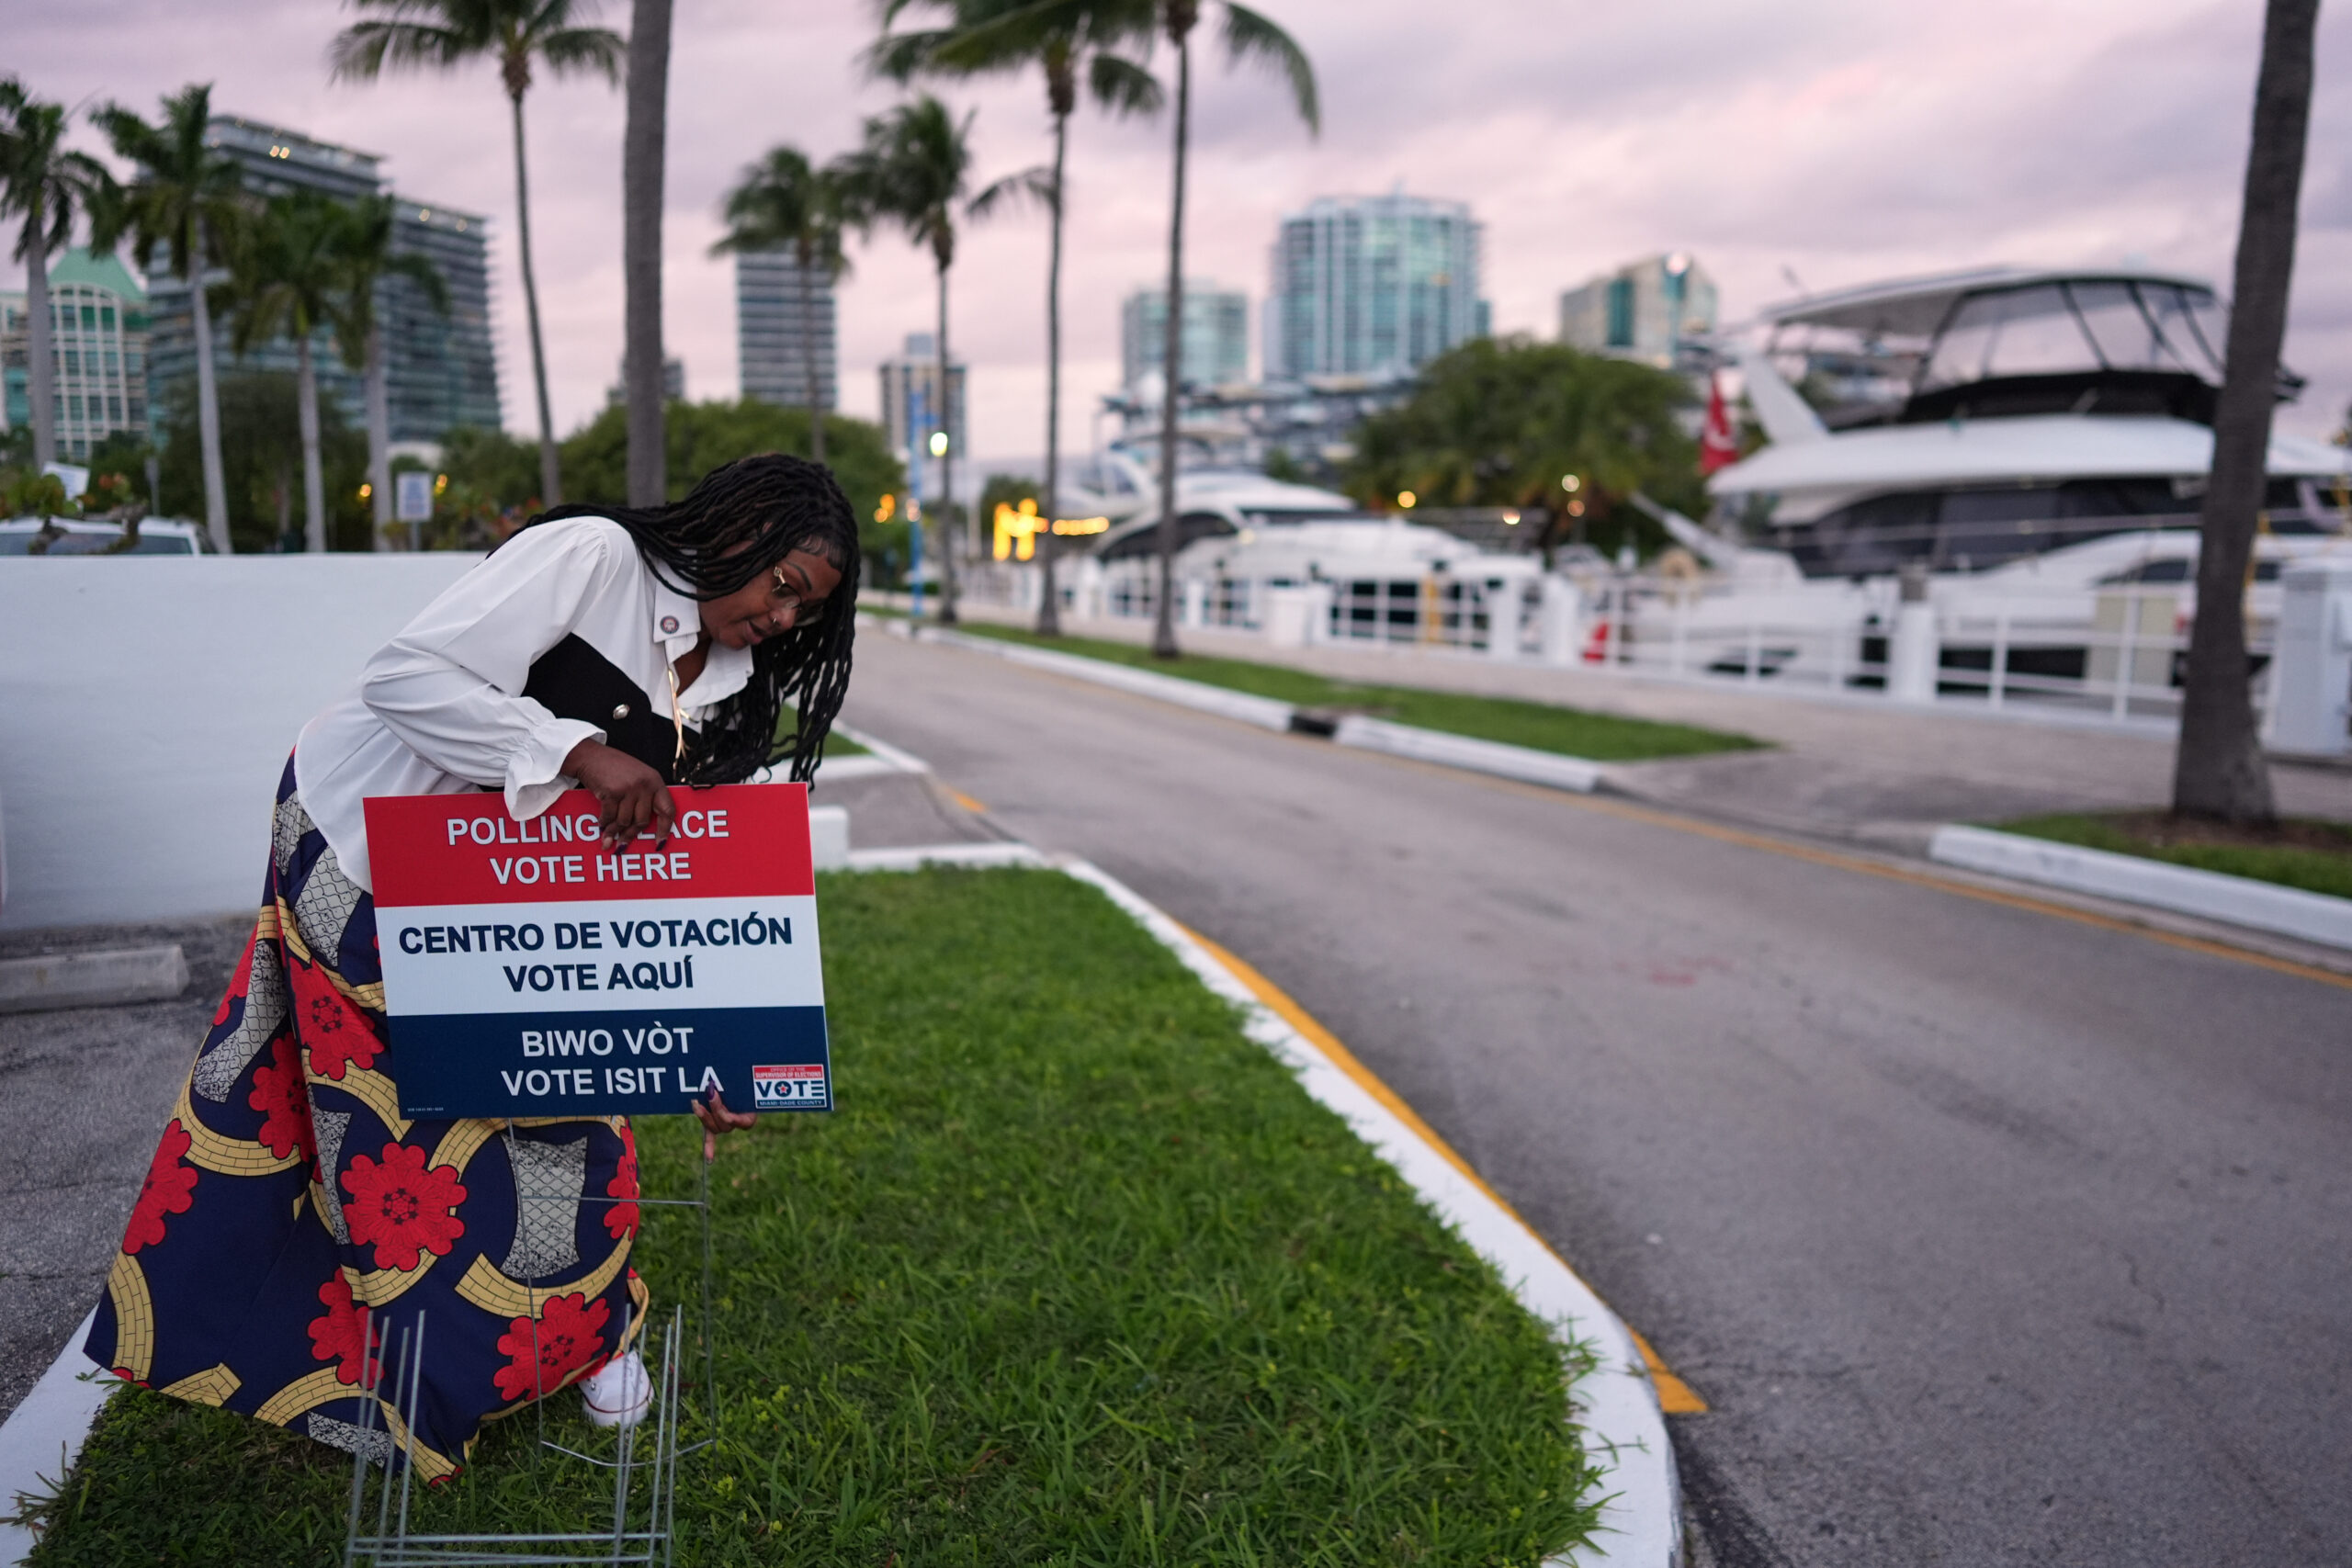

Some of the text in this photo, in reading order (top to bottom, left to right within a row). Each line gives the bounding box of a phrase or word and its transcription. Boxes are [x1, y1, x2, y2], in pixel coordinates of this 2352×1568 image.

[447, 813, 600, 846] POLLING
[490, 852, 692, 885] VOTE HERE
[399, 911, 792, 954] CENTRO DE VOTACIÓN
[503, 954, 694, 992] VOTE AQUÍ
[522, 1021, 694, 1057] BIWO VÒT
[500, 1066, 724, 1096] VOTE ISIT LA
[755, 1080, 825, 1098] VOTE
